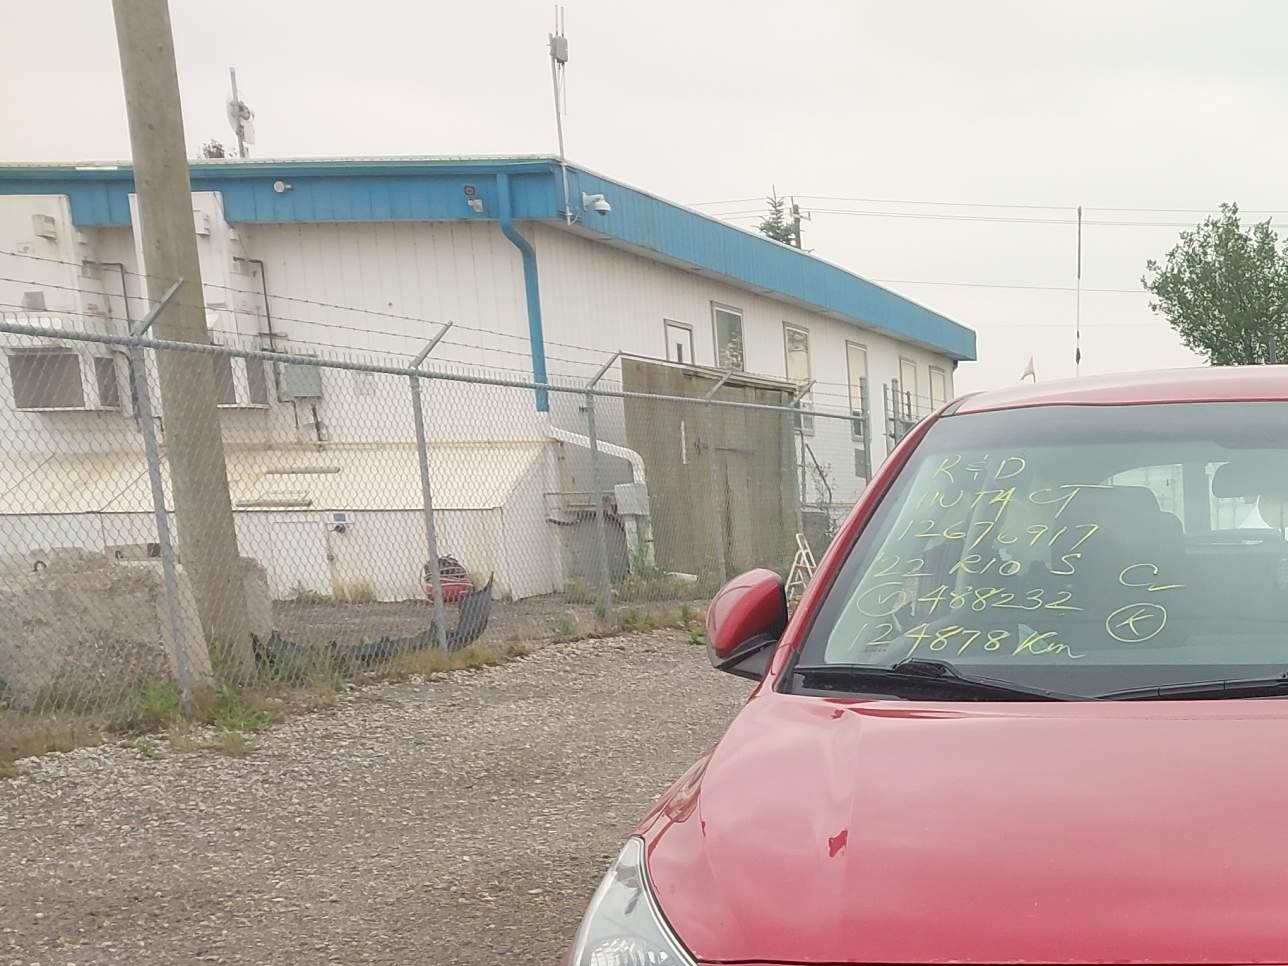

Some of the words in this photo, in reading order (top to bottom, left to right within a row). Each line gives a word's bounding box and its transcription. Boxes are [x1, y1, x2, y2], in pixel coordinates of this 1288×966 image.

[898, 519, 1100, 551] 12676917
[1049, 552, 1083, 576] S
[917, 584, 1085, 614] 488232
